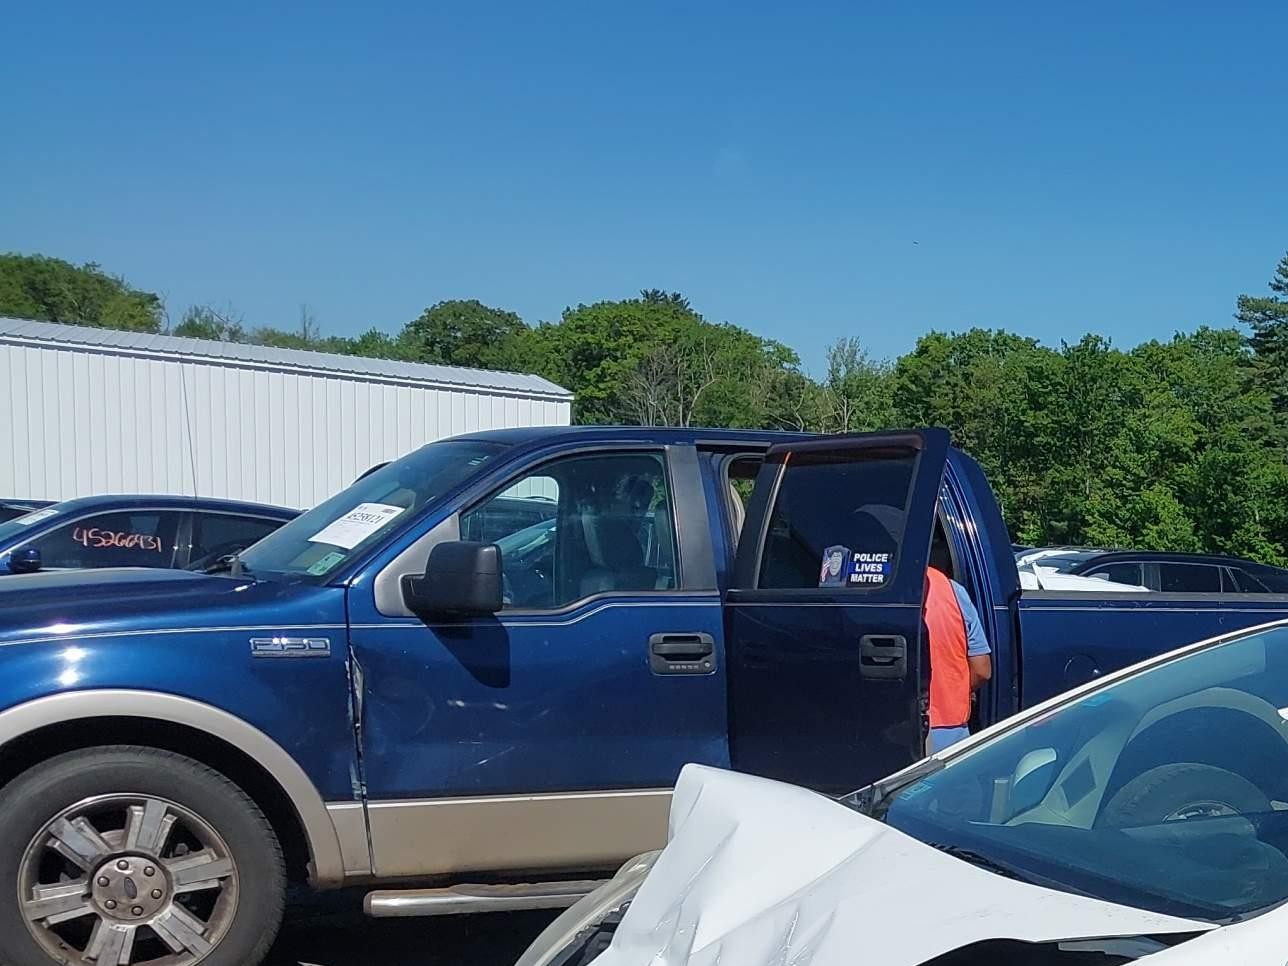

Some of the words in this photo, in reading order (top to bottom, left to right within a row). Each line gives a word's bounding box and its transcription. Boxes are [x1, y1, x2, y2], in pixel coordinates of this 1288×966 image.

[853, 553, 888, 562] POLICE
[855, 563, 883, 572] LIVES
[850, 574, 884, 583] MATTER
